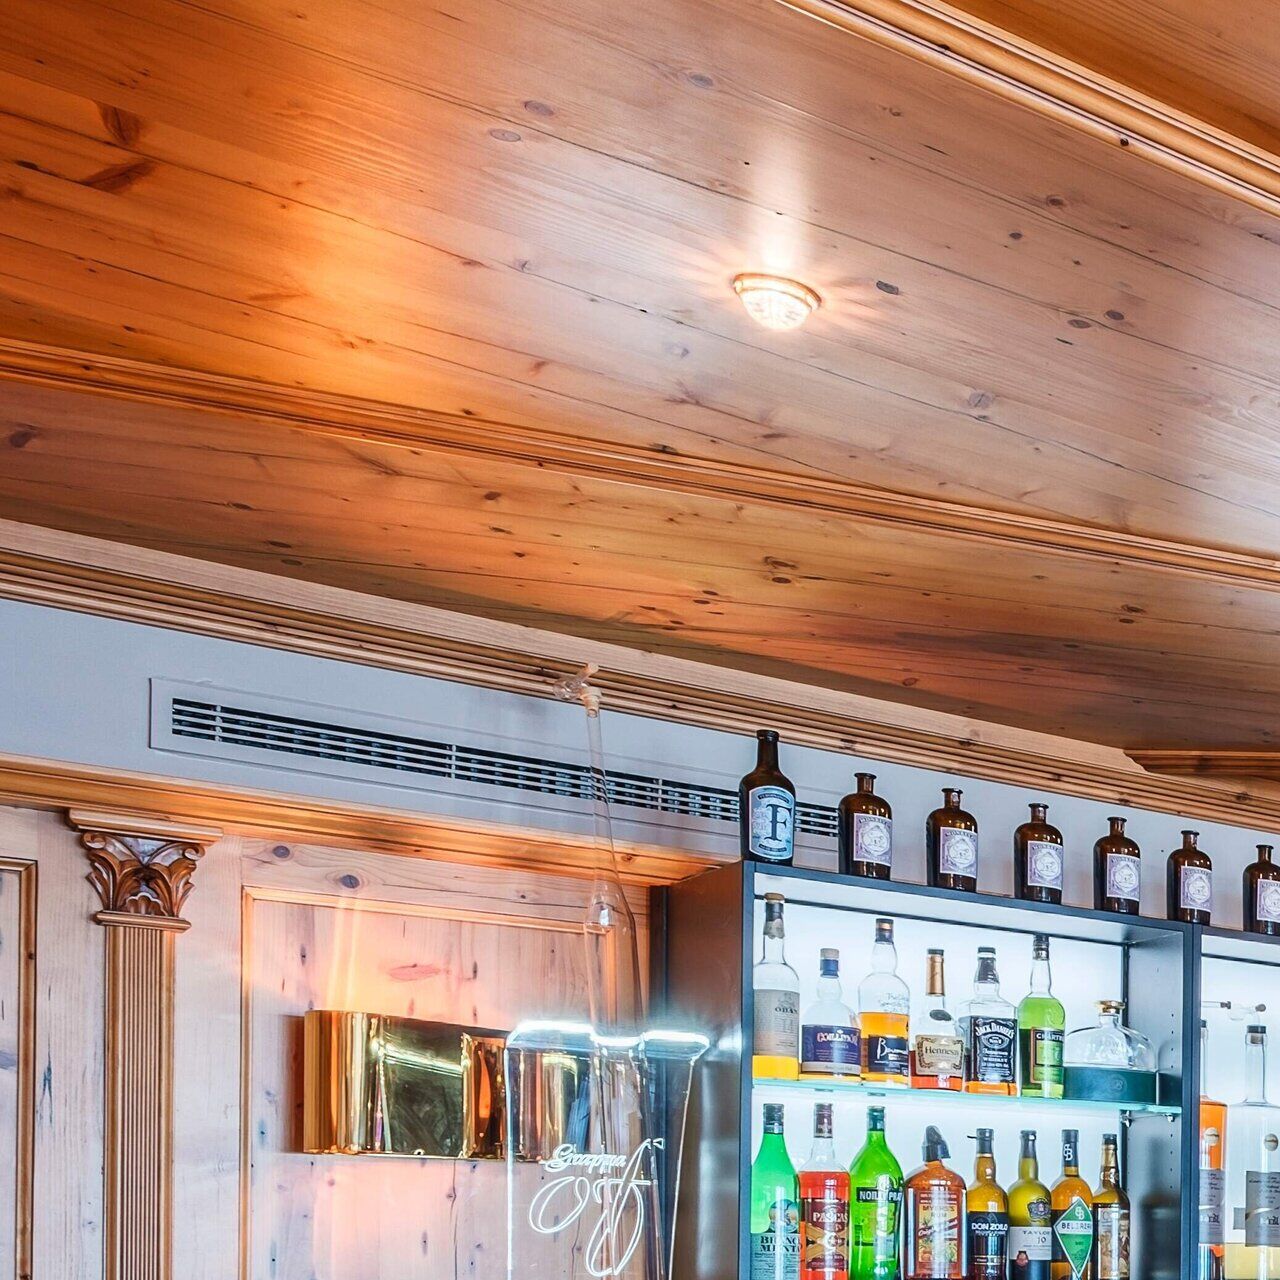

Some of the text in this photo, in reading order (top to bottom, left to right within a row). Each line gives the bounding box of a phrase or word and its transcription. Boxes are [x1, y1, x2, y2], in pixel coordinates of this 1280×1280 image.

[975, 1023, 991, 1037] JACK
[539, 1143, 627, 1174] Grappa
[971, 1222, 989, 1230] DON
